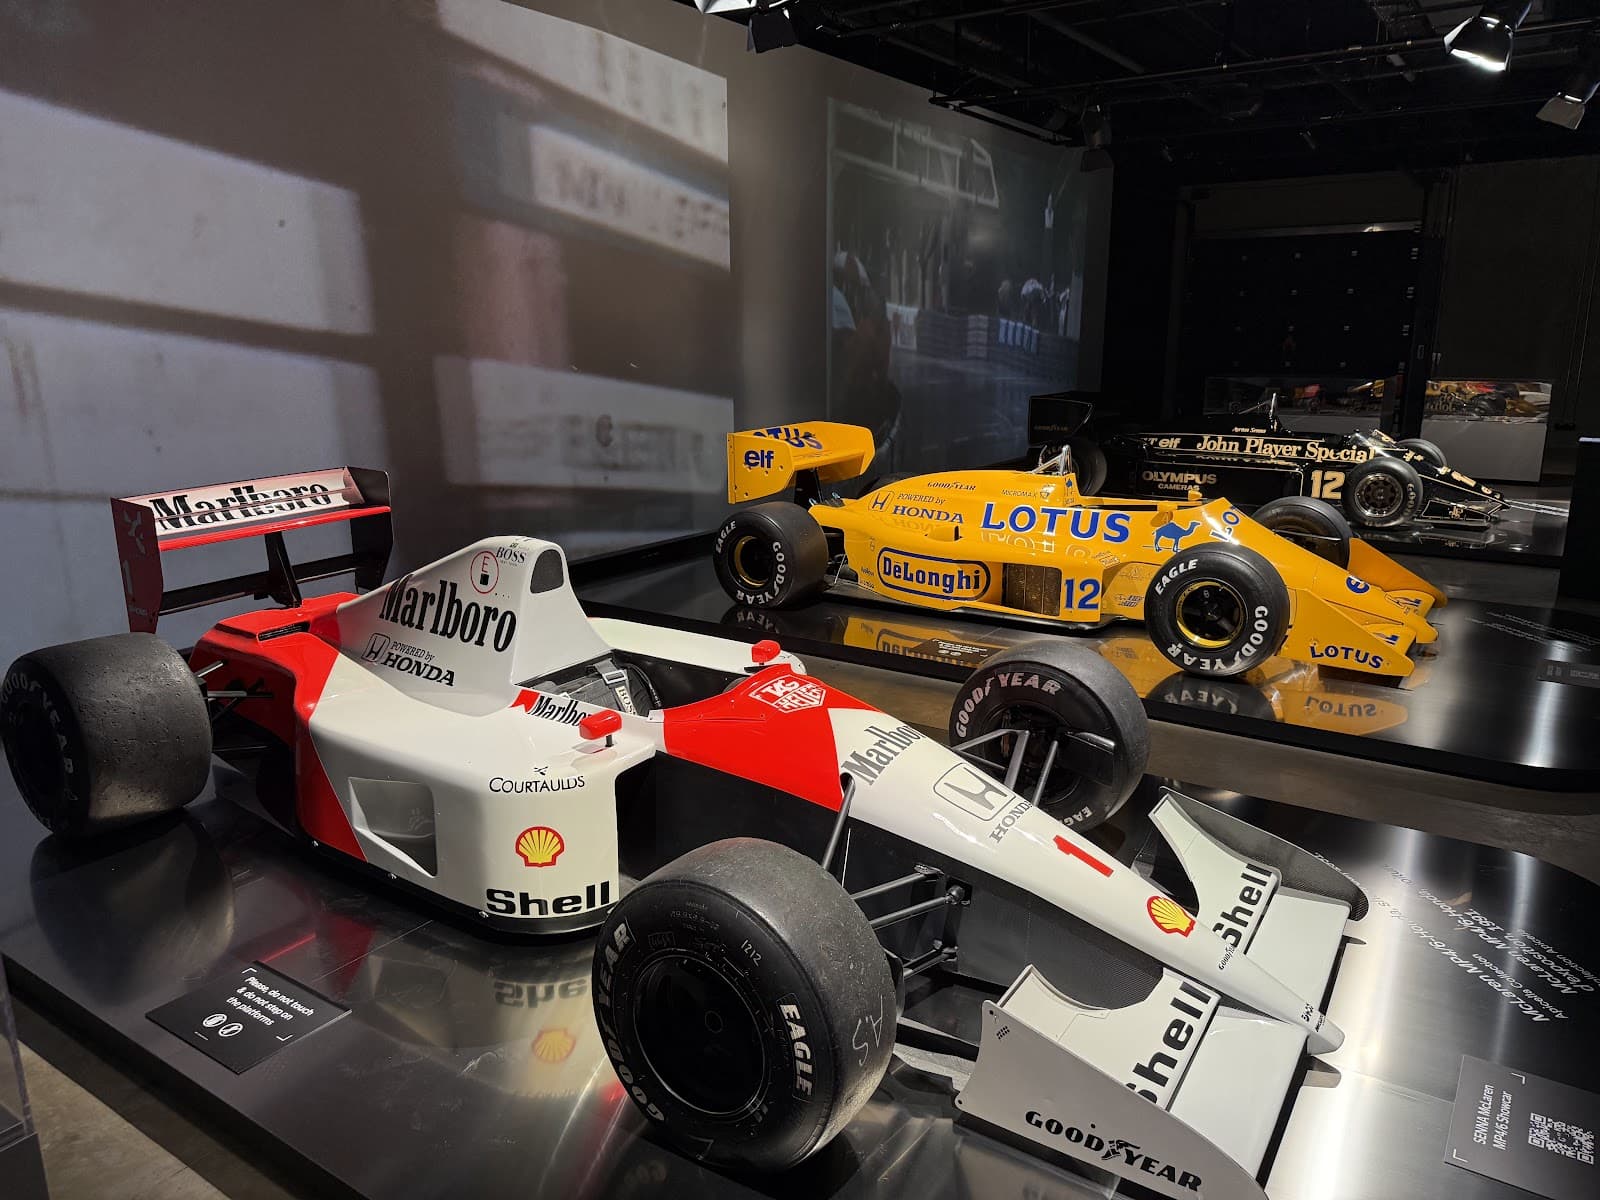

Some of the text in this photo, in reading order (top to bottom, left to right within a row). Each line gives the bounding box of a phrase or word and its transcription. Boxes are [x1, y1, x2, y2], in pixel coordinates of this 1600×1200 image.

[744, 450, 774, 468] elf
[1158, 438, 1181, 449] elf
[1197, 435, 1375, 463] John Player Special
[1142, 471, 1217, 485] OLYMPUS
[1157, 483, 1200, 491] CAMERAS
[1310, 470, 1345, 499] 12
[149, 483, 331, 530] Marlboro
[892, 505, 964, 524] HONDA
[898, 493, 945, 506] POWERED by
[716, 520, 737, 553] EAGLE
[981, 502, 1131, 543] LOTUS
[495, 545, 527, 564] BOSS
[883, 557, 981, 593] DeLonghi
[1155, 559, 1198, 595] EAGLE
[1065, 578, 1101, 610] 12
[379, 573, 517, 653] Marlboro
[389, 641, 436, 662] POWERED by
[1310, 644, 1384, 669] LOTUS
[381, 652, 456, 687] HONDA
[759, 679, 801, 698] TAG
[775, 683, 824, 710] HEUER
[954, 672, 1064, 738] GOODYEAR
[530, 694, 592, 728] Marlbo
[841, 723, 925, 786] Marlbo
[488, 775, 586, 794] COURTAULDS
[1052, 834, 1114, 878] 1
[486, 881, 611, 916] Shell
[1472, 953, 1569, 1020] Apicella Collection
[1508, 951, 1579, 995] McLaren
[226, 996, 276, 1026] the platforms
[236, 986, 295, 1021] & do not step on
[244, 976, 316, 1017] Please, do not touch
[1479, 975, 1551, 1022] McLaren
[778, 1003, 814, 1097] EAGLE
[1473, 1083, 1495, 1145] SENNA McLaren
[1492, 1090, 1513, 1151] MP4/6 Showcar
[1025, 1111, 1203, 1192] GOODYEAR
